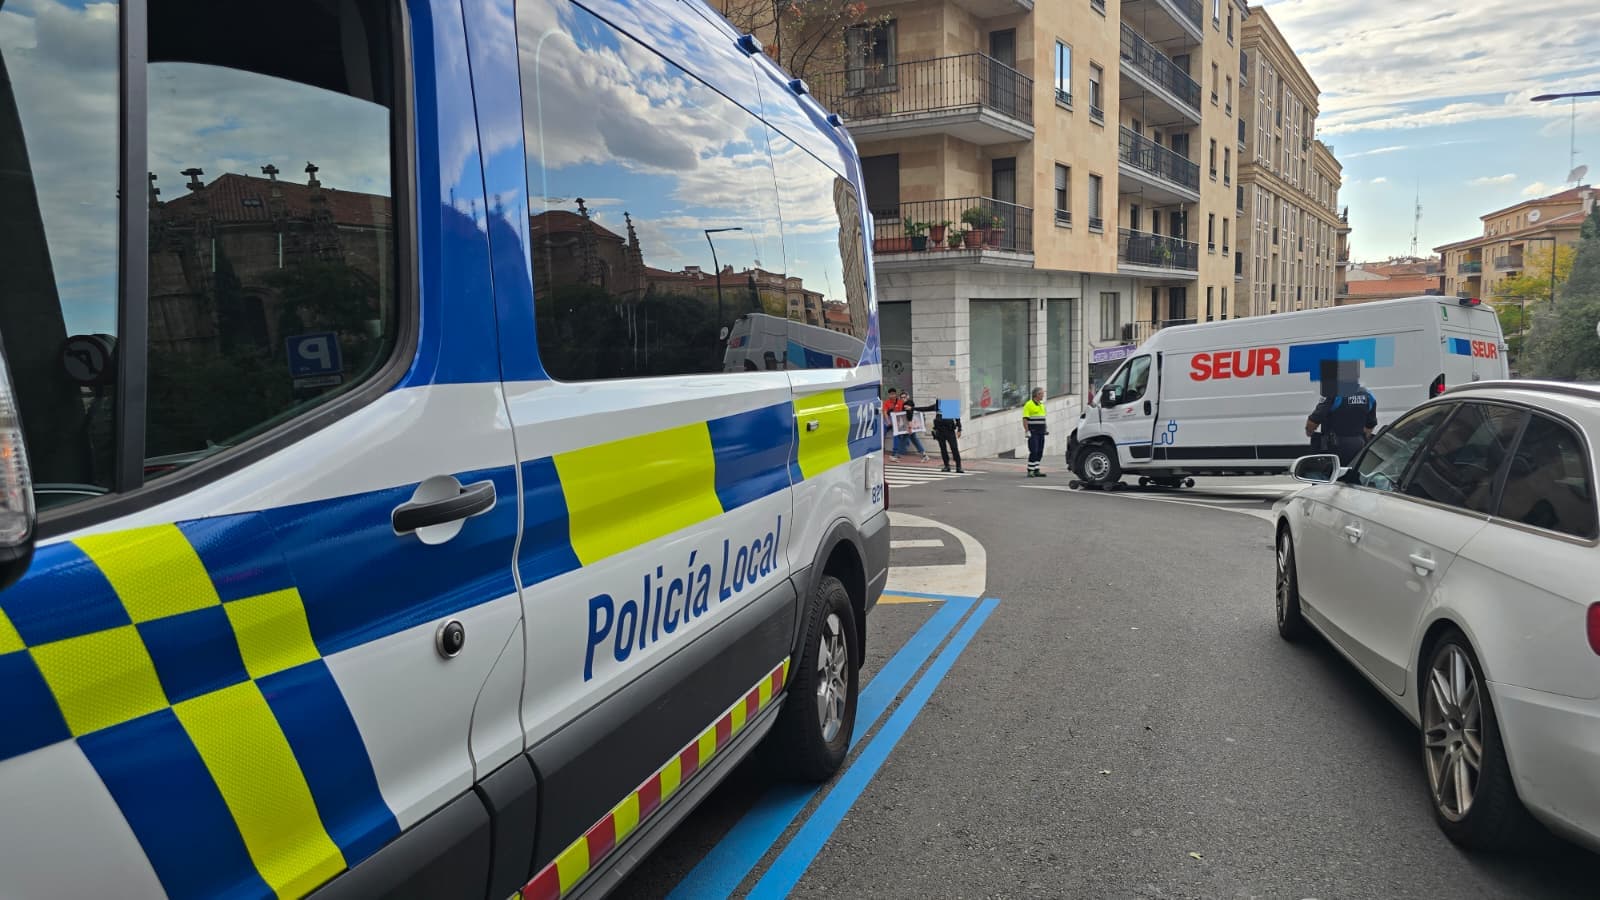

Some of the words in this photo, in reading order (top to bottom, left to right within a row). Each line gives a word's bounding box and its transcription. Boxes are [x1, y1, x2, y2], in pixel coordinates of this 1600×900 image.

[1190, 347, 1281, 381] SEUR
[1472, 340, 1498, 359] SEUR
[856, 402, 875, 440] 112
[584, 550, 711, 682] Policía
[719, 515, 781, 603] Local
